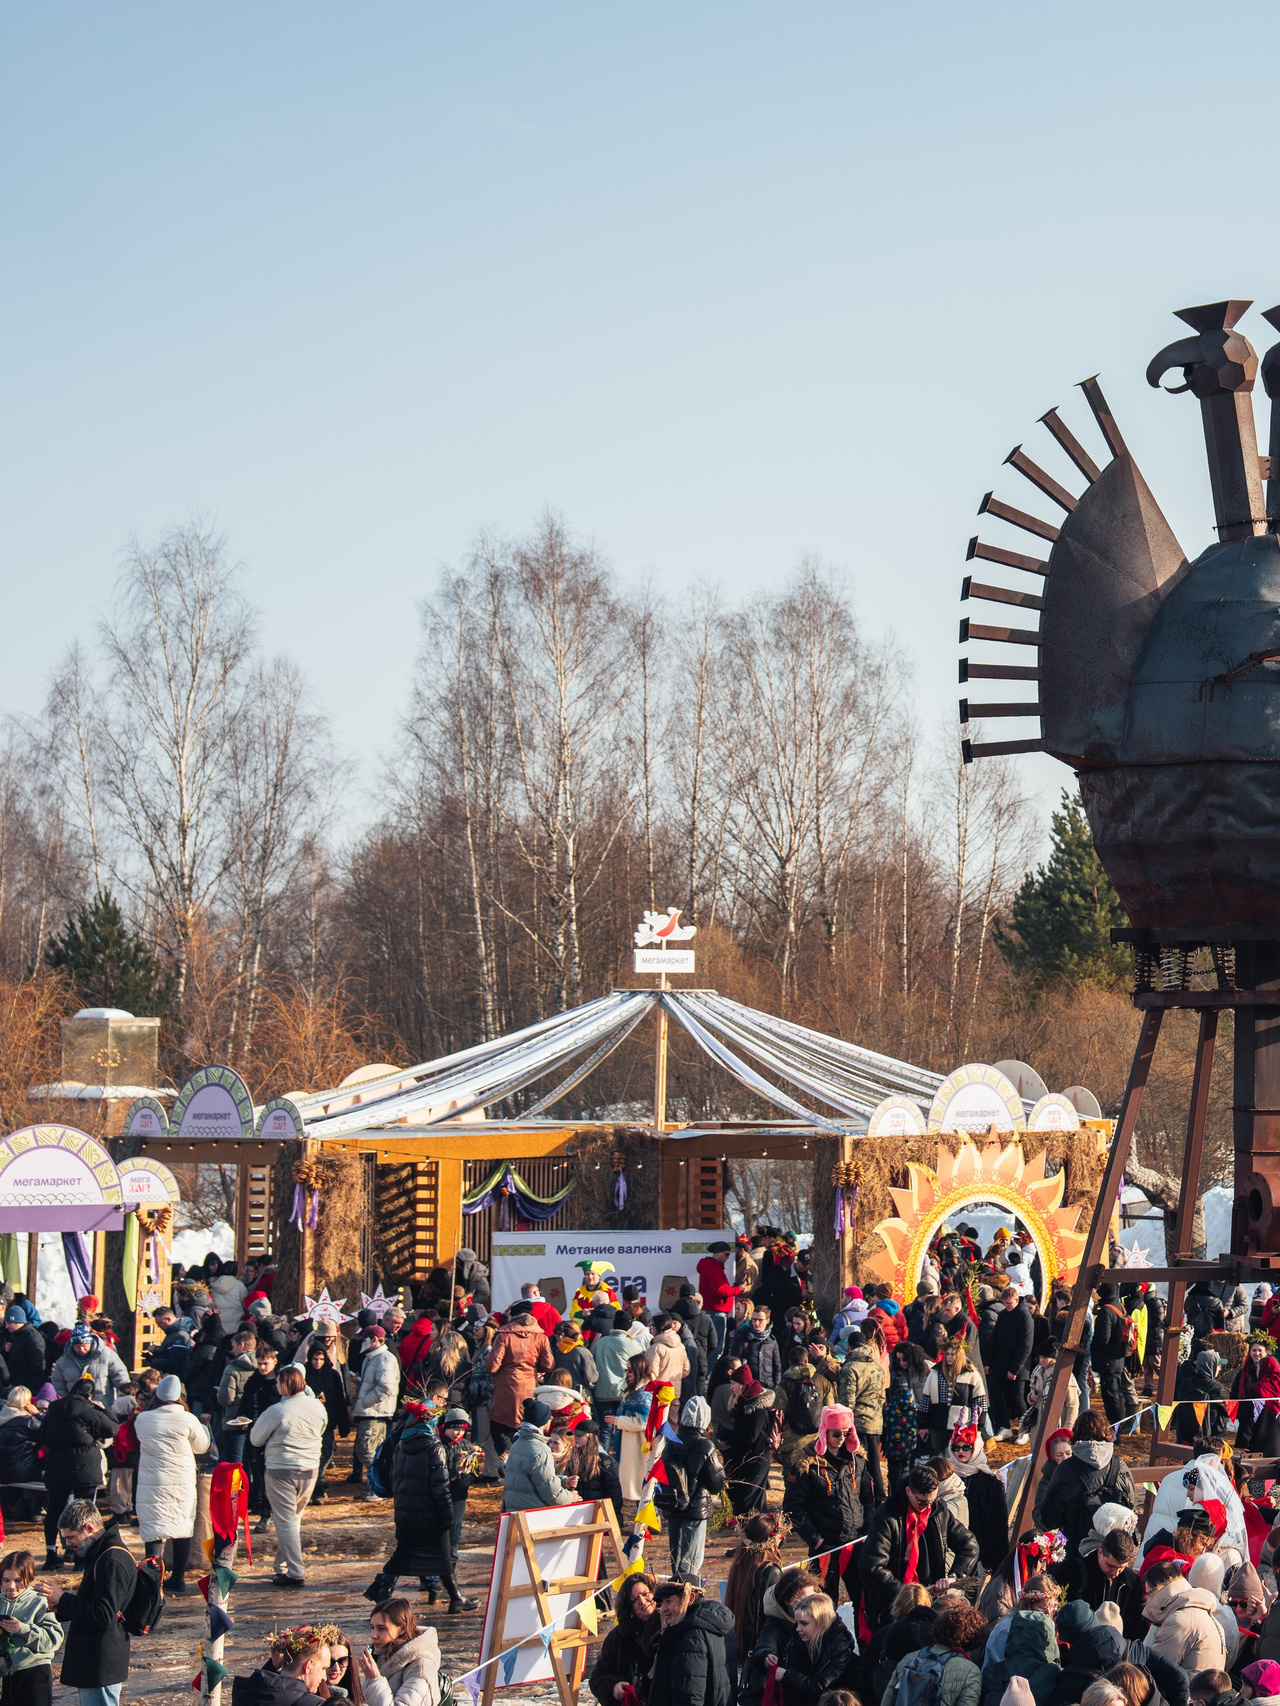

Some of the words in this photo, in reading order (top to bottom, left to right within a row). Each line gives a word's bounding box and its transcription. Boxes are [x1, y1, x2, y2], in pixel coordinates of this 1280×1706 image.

[641, 957, 689, 965] мегамаркет
[192, 1112, 231, 1121] мегамаркет
[955, 1109, 1000, 1118] мегамаркет
[13, 1177, 82, 1187] мегамаркет
[555, 1245, 615, 1255] Метание
[617, 1245, 672, 1254] валенка
